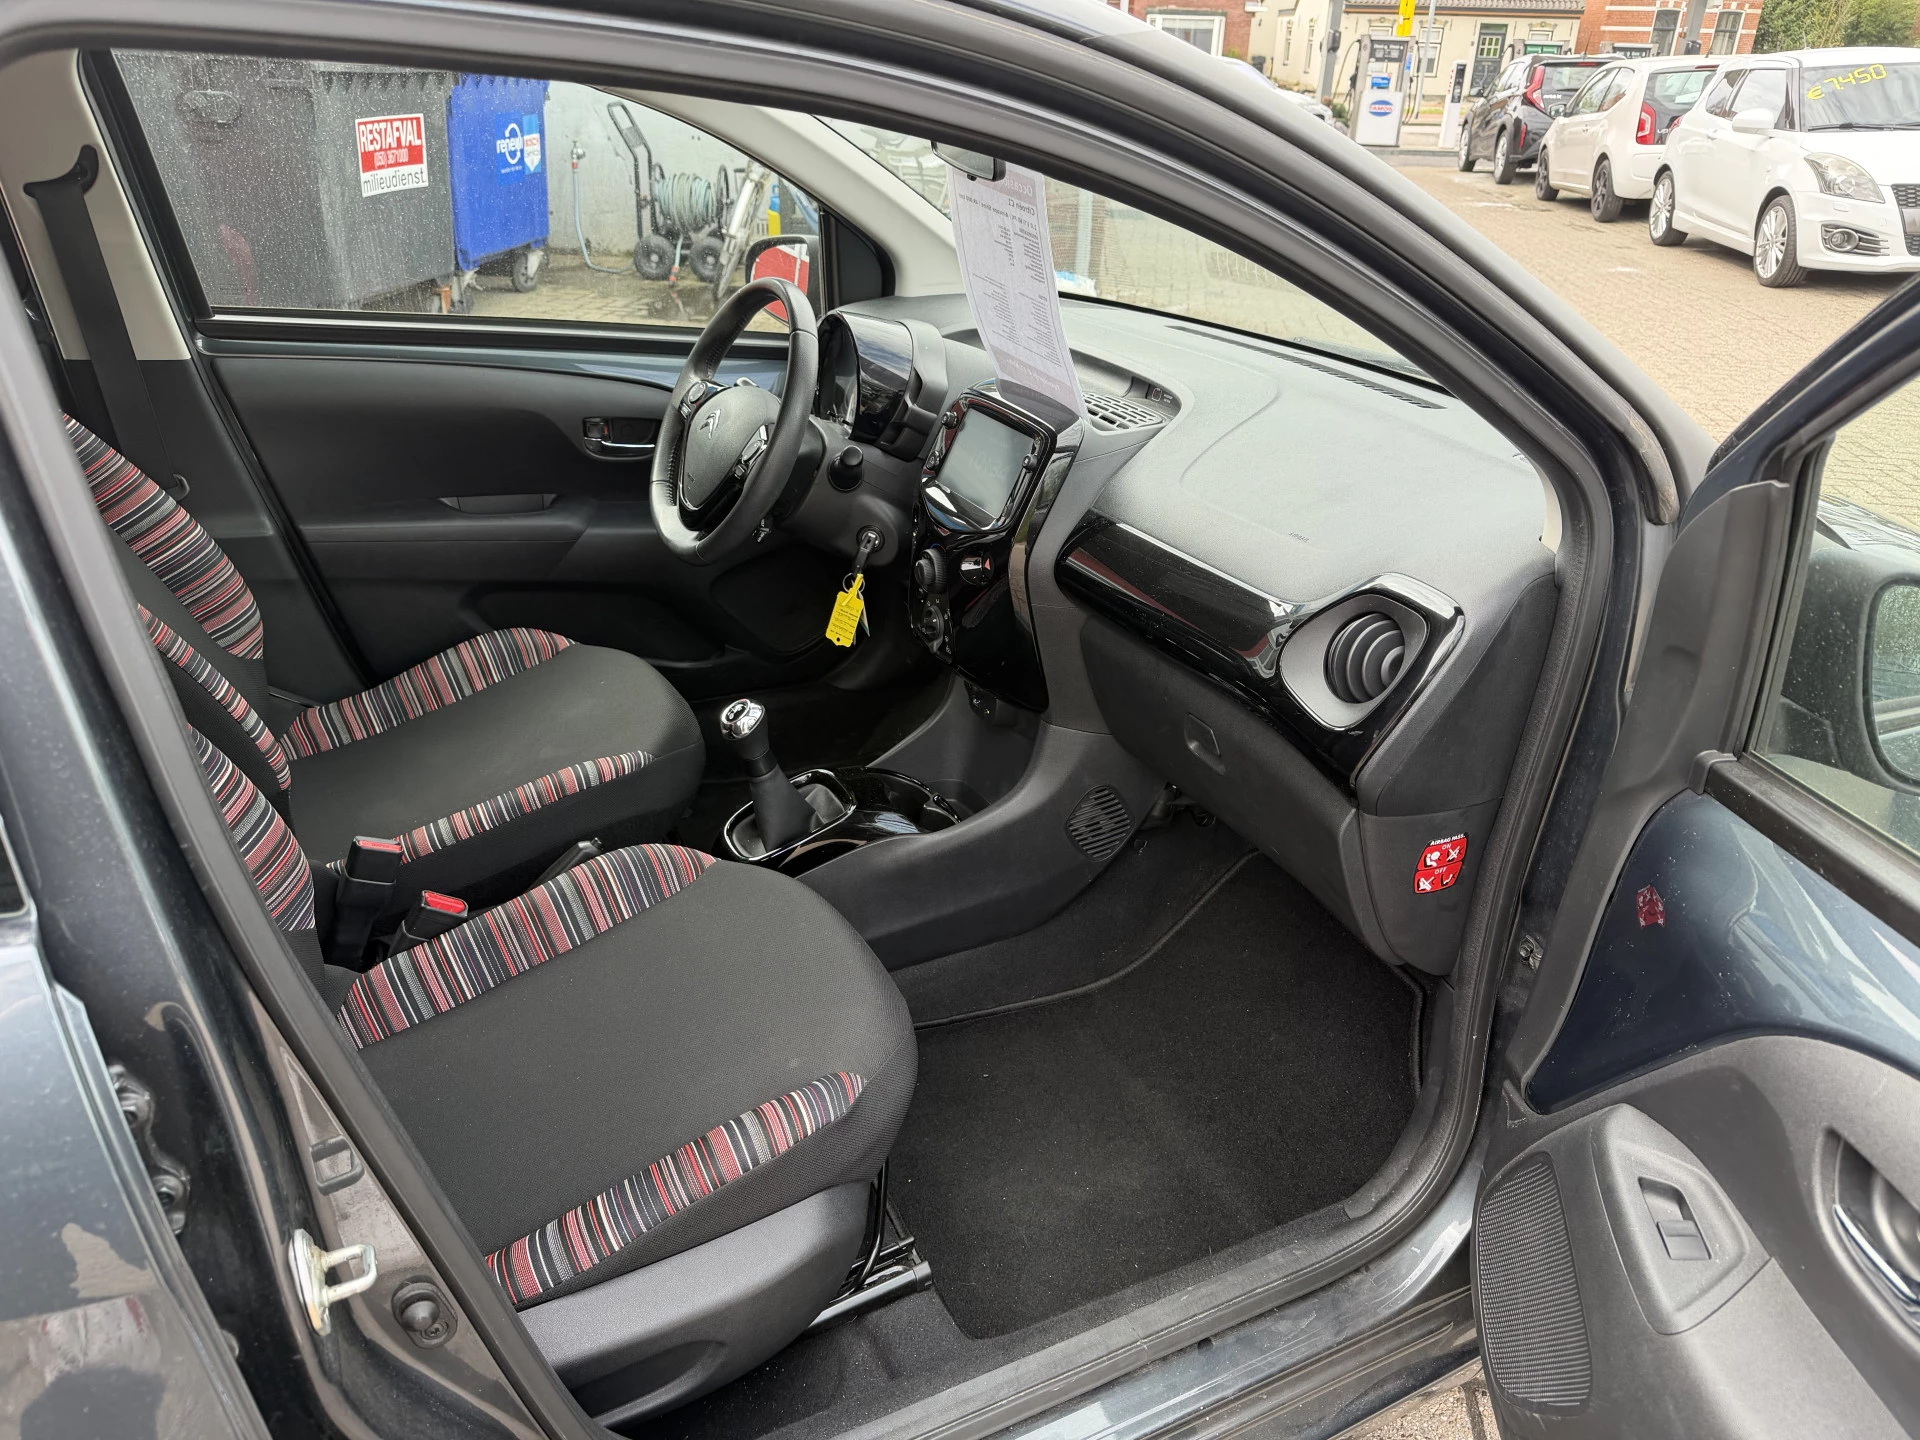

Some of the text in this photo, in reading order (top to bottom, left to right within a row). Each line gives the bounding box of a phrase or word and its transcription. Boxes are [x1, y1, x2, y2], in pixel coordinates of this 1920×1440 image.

[1807, 63, 1888, 100] € 7.450
[359, 119, 421, 153] RESTAFVAL
[363, 168, 426, 194] milieudienst
[1430, 833, 1466, 846] AIRBAG PASS.
